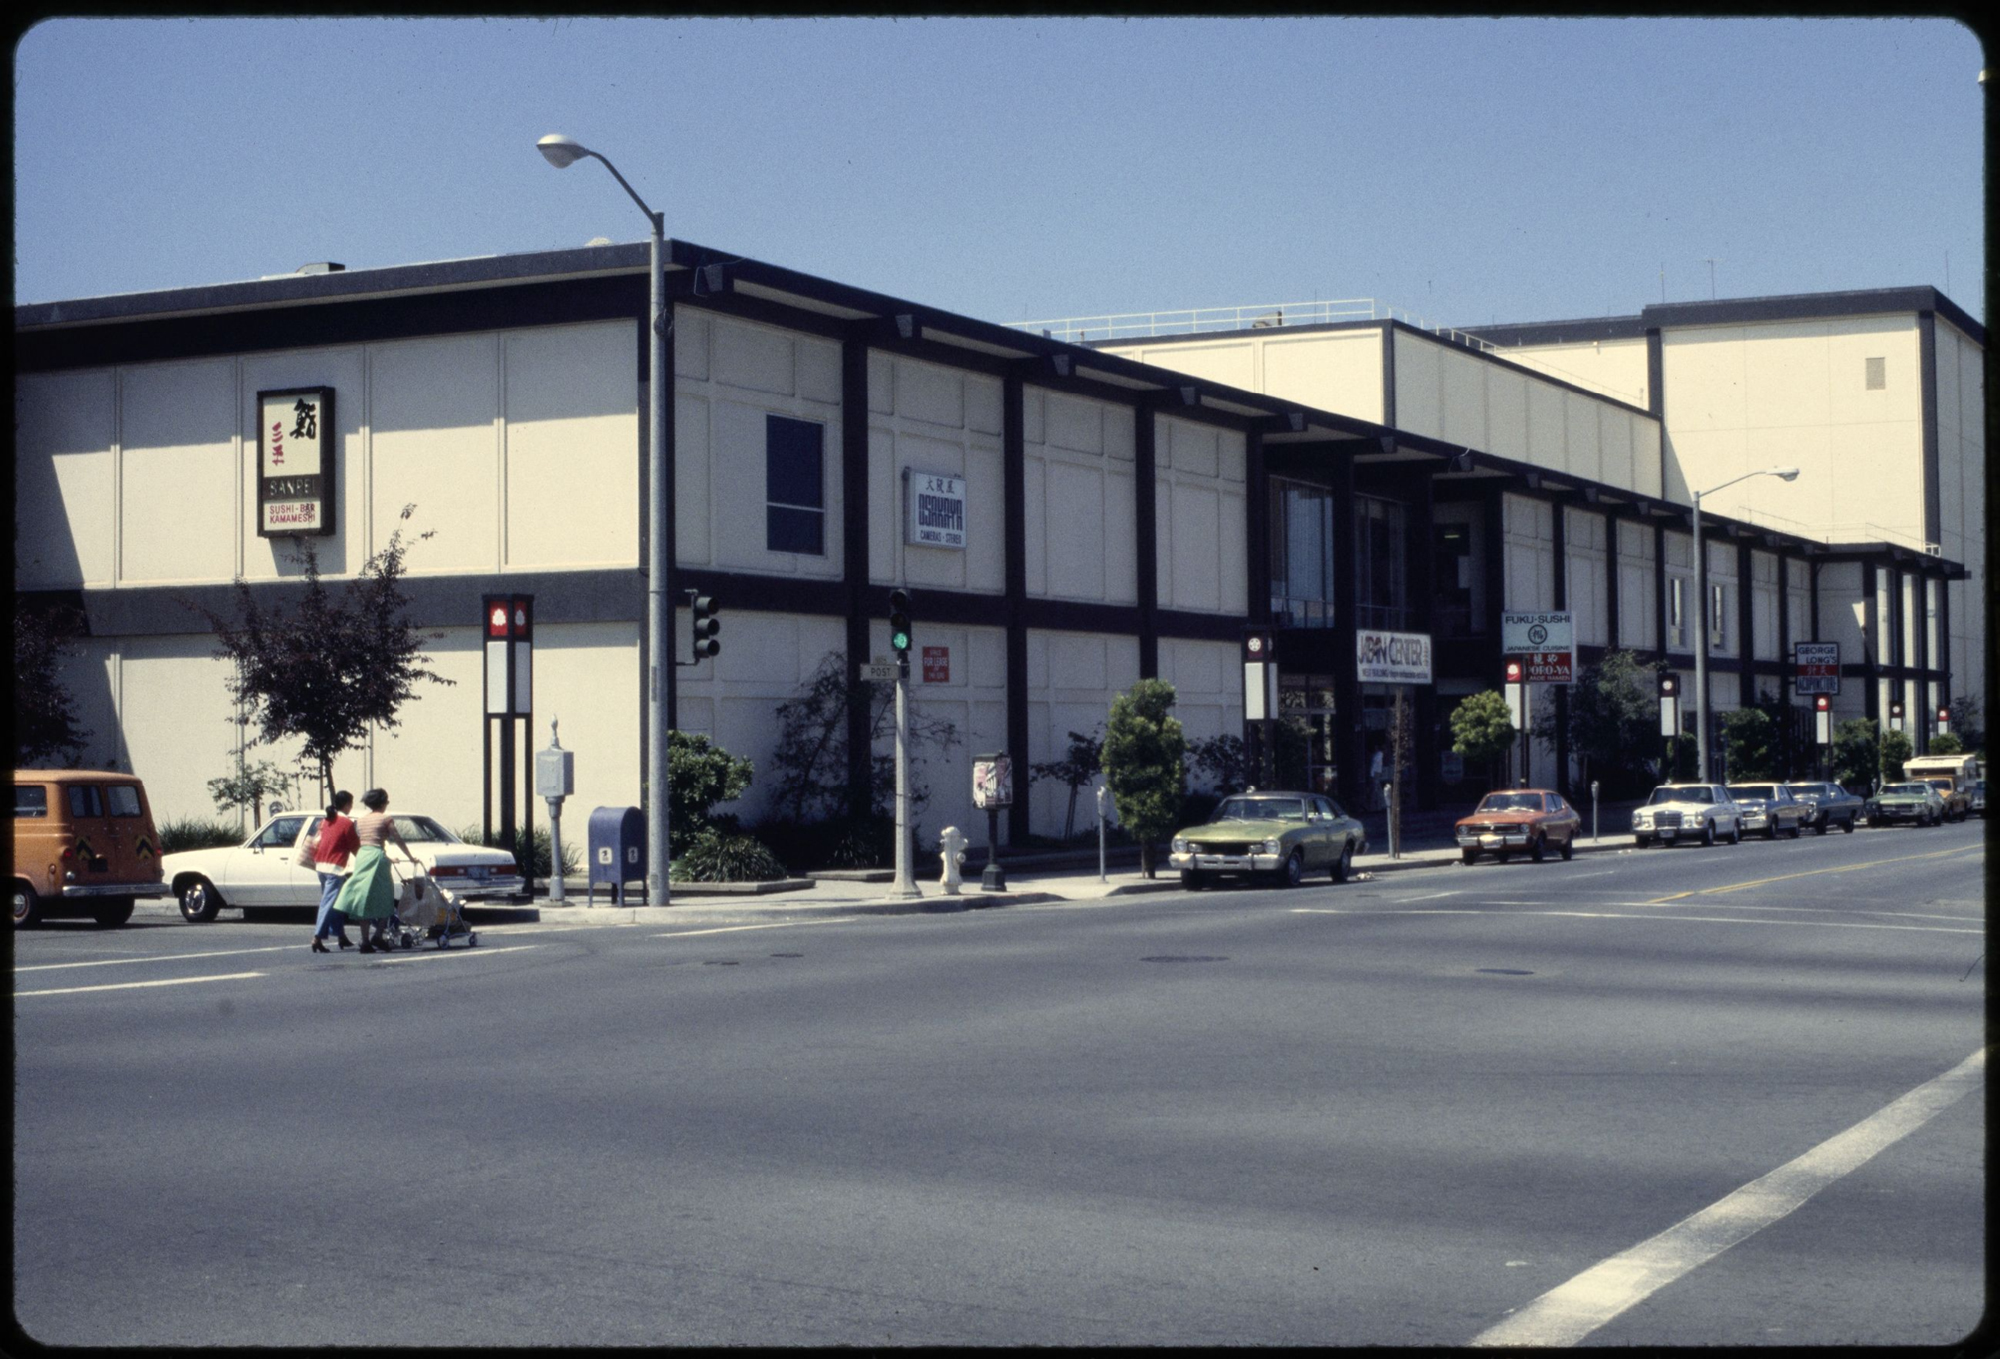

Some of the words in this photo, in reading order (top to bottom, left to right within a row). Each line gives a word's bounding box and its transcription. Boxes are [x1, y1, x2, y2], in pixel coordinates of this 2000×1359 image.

[269, 479, 316, 496] SANPEI
[919, 493, 963, 531] OSAKAYA
[269, 513, 316, 524] KAMAMESHI
[920, 530, 941, 541] CAMERAS
[946, 533, 961, 544] STEREO
[1388, 636, 1422, 666] CENTER
[934, 656, 948, 667] LEASE
[1806, 655, 1837, 663] LONG'S
[870, 667, 891, 677] POST
